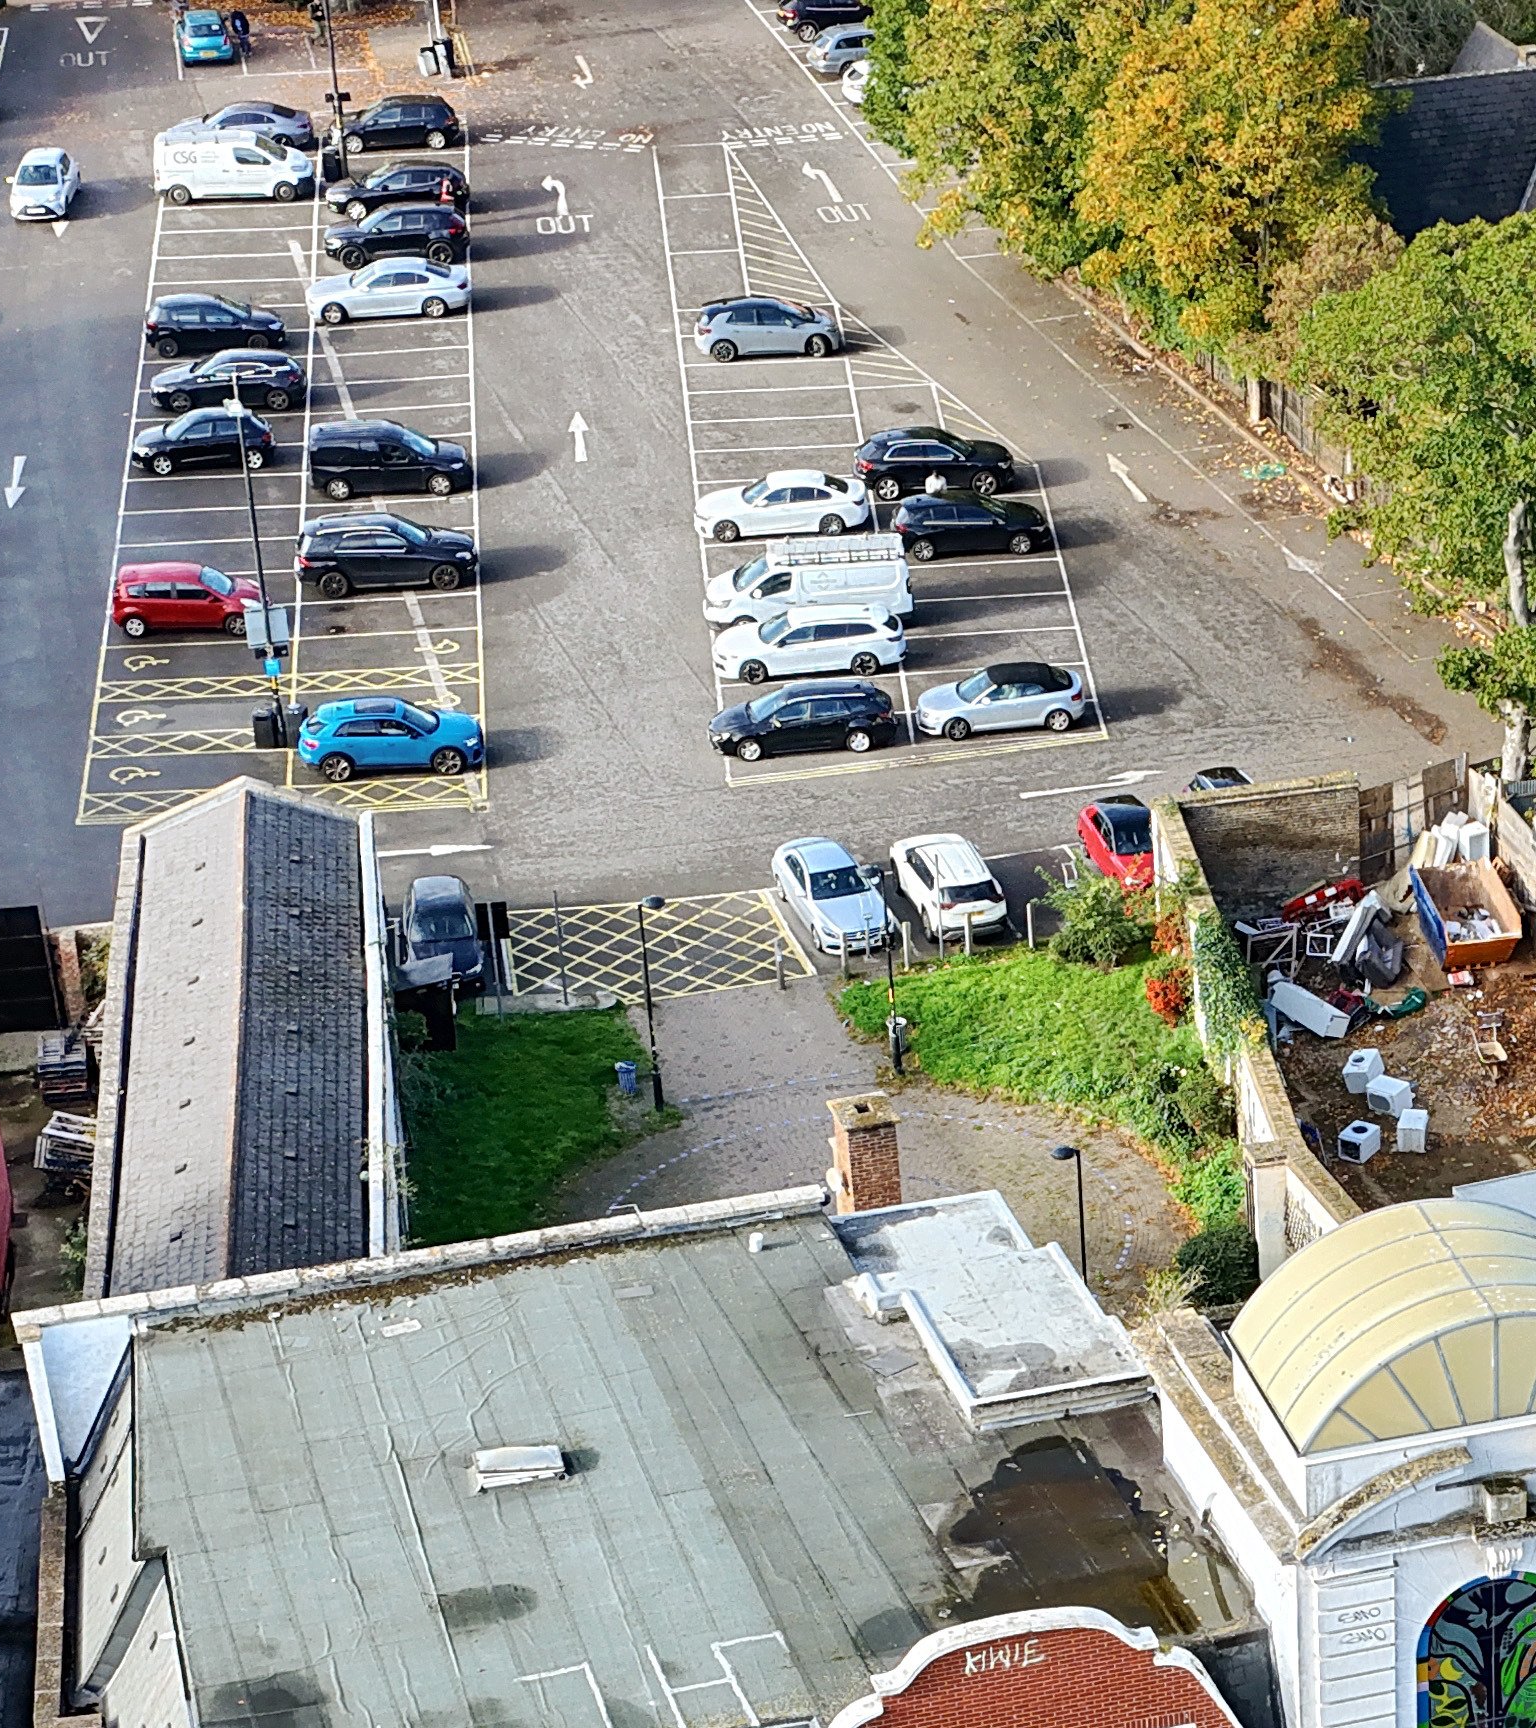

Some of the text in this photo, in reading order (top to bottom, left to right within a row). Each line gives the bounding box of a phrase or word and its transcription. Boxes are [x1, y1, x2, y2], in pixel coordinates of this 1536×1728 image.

[59, 50, 112, 67] OUT
[721, 121, 835, 142] NO ENTRY
[817, 204, 872, 223] OUT
[536, 214, 593, 234] OUT
